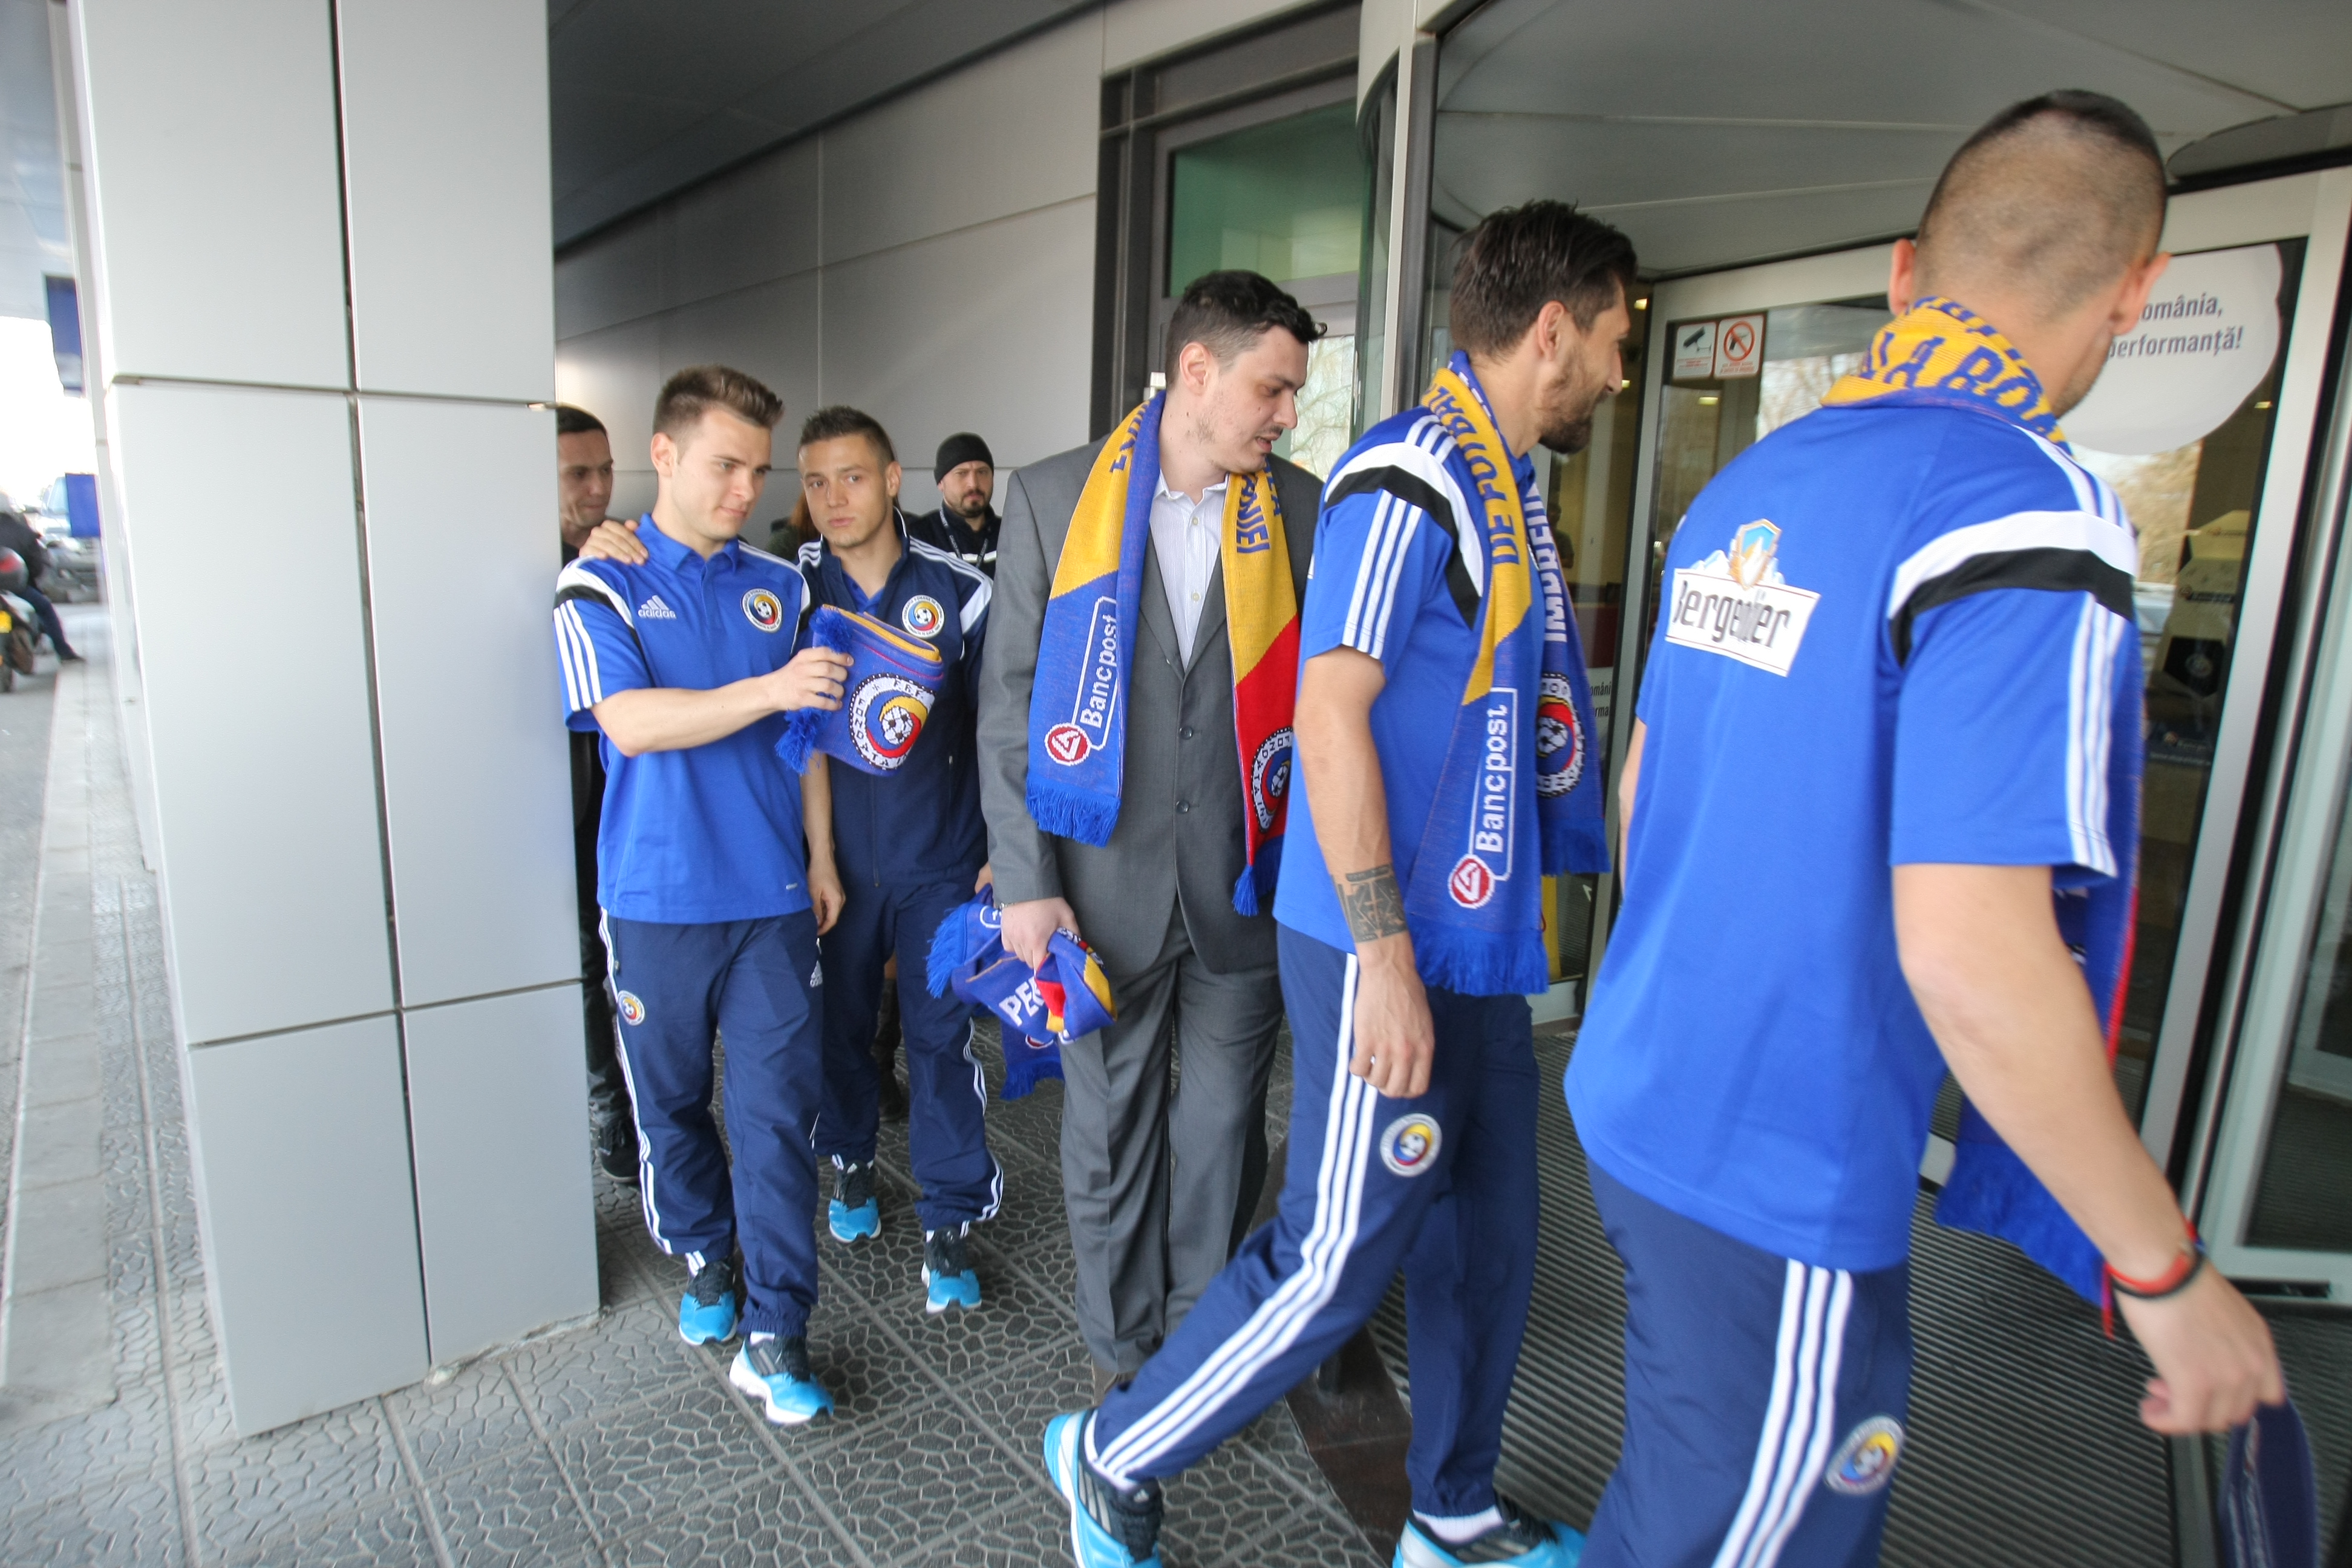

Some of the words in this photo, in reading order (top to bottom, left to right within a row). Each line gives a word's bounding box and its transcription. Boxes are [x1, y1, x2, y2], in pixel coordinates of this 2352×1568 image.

[2142, 292, 2223, 321] omânia,
[638, 609, 676, 619] adidas
[1080, 615, 1117, 728] Bancpost
[1590, 681, 1612, 696] omâni
[854, 697, 889, 767] FONDATA
[1253, 735, 1290, 795] FONDATA
[1475, 704, 1512, 852] Bancpost
